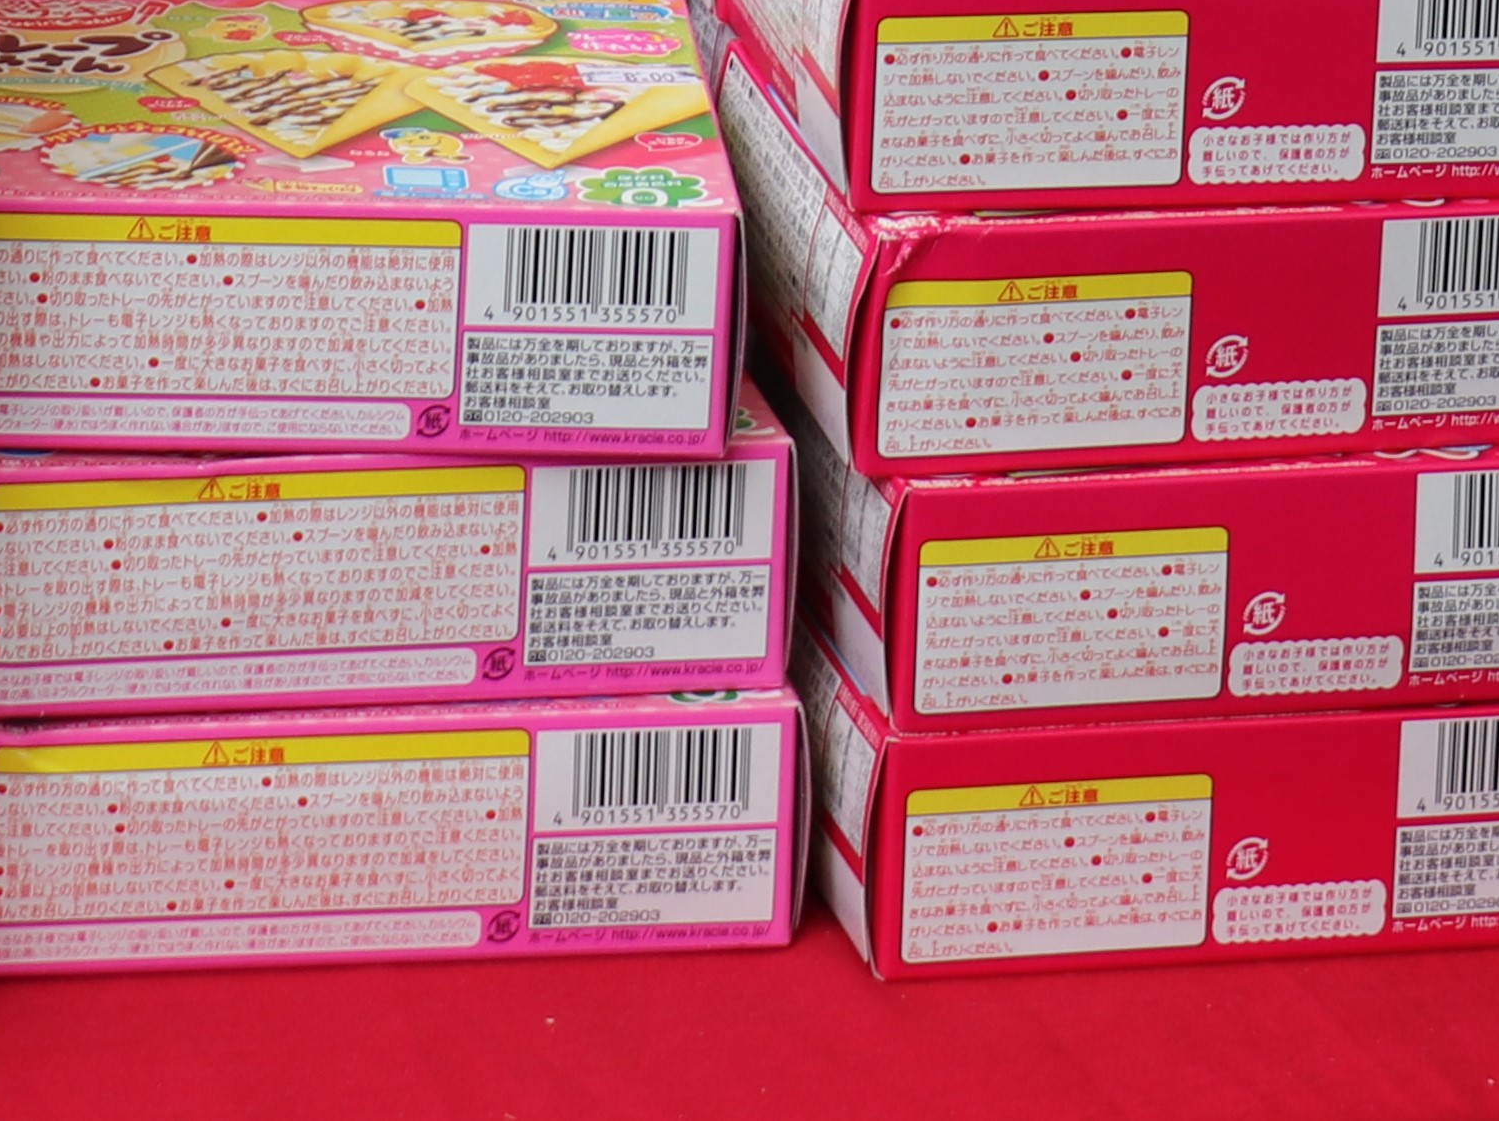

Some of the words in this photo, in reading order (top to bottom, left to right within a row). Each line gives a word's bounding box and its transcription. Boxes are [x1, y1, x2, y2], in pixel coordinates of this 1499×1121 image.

[1023, 21, 1074, 37] ご注意
[1396, 43, 1406, 56] 4
[1424, 40, 1495, 56] 901551
[158, 223, 212, 242] ご注意
[484, 307, 494, 320] 4
[513, 306, 588, 321] 901551
[601, 307, 676, 323] 355570
[547, 547, 556, 560] 4
[575, 544, 649, 559] 901551
[660, 540, 734, 556] 355570
[1433, 553, 1443, 567] 4
